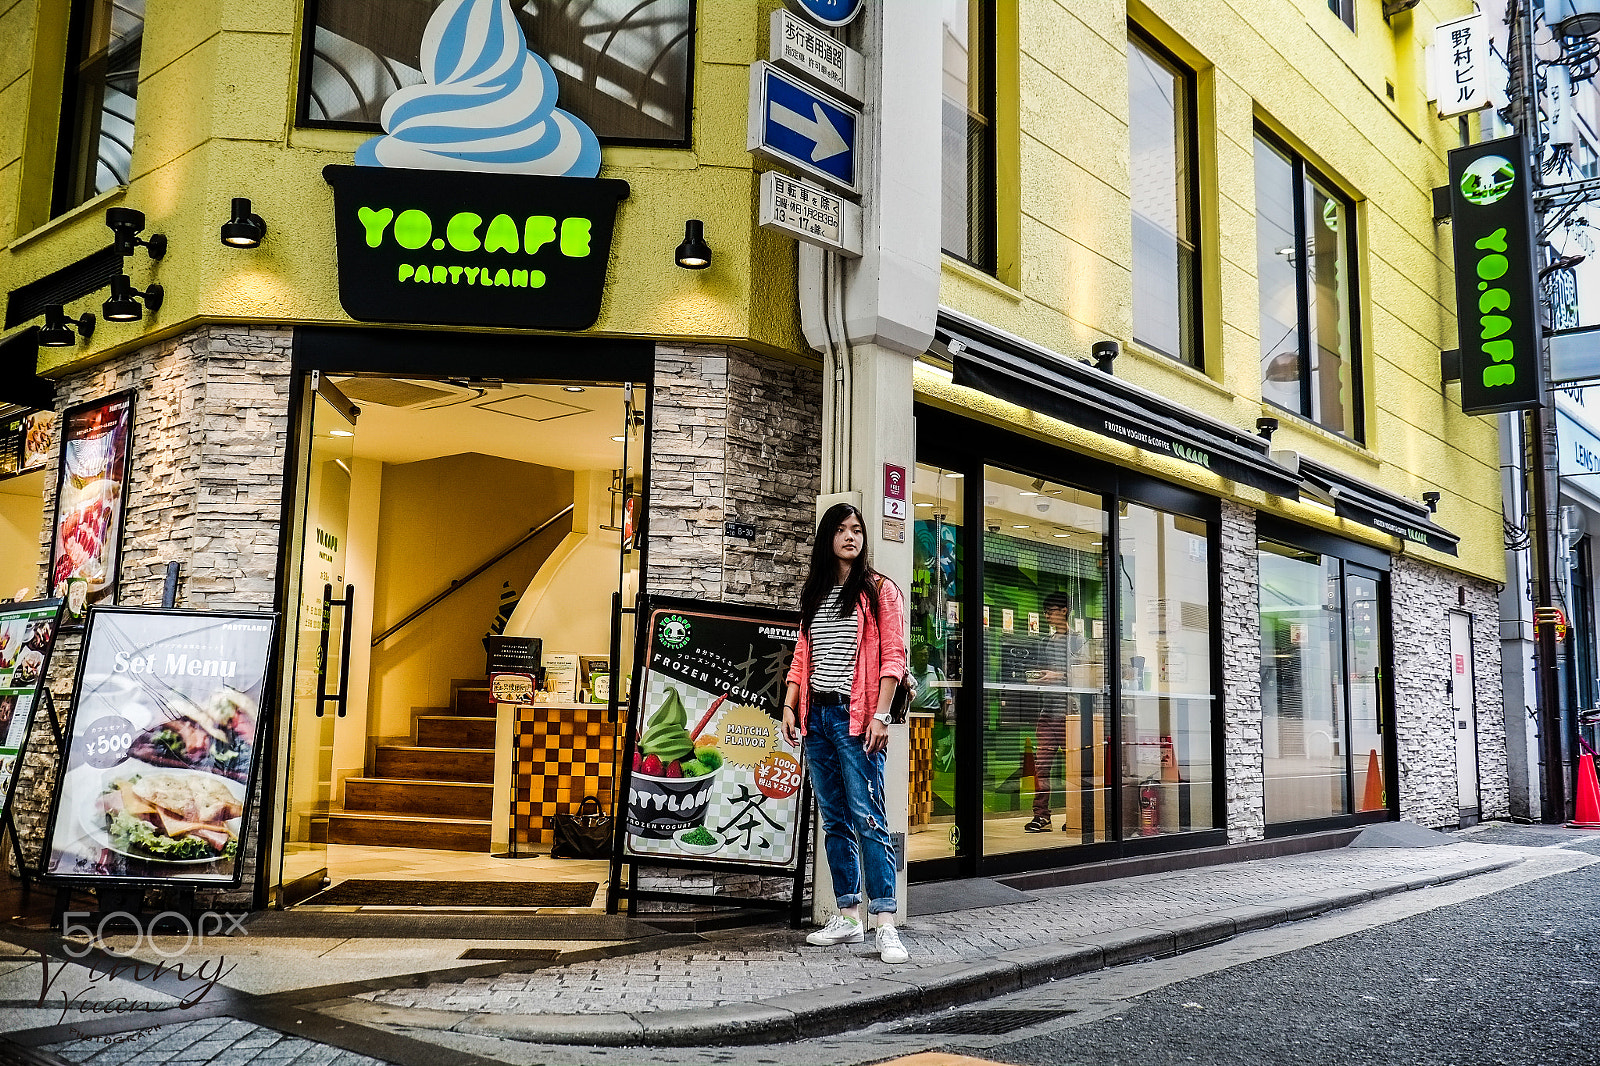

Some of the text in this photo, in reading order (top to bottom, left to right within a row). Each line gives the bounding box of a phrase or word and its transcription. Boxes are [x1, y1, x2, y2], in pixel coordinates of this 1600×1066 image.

[785, 21, 843, 69] 歩行者用道路
[1450, 28, 1476, 103] 野村ビル
[357, 206, 592, 258] YO.CAFE
[398, 263, 546, 289] PARTYLAND
[1474, 227, 1517, 388] YO.CAFE
[1574, 441, 1593, 472] LENS
[891, 502, 899, 515] 2
[113, 650, 237, 678] Set Menu
[653, 653, 768, 706] FROZEN YOGURT
[86, 732, 132, 756] ¥500
[724, 735, 766, 748] FLAVOR
[726, 724, 770, 737] MATCHA
[774, 757, 797, 773] 100g
[660, 822, 692, 830] YOGURT
[716, 783, 785, 851] 茶
